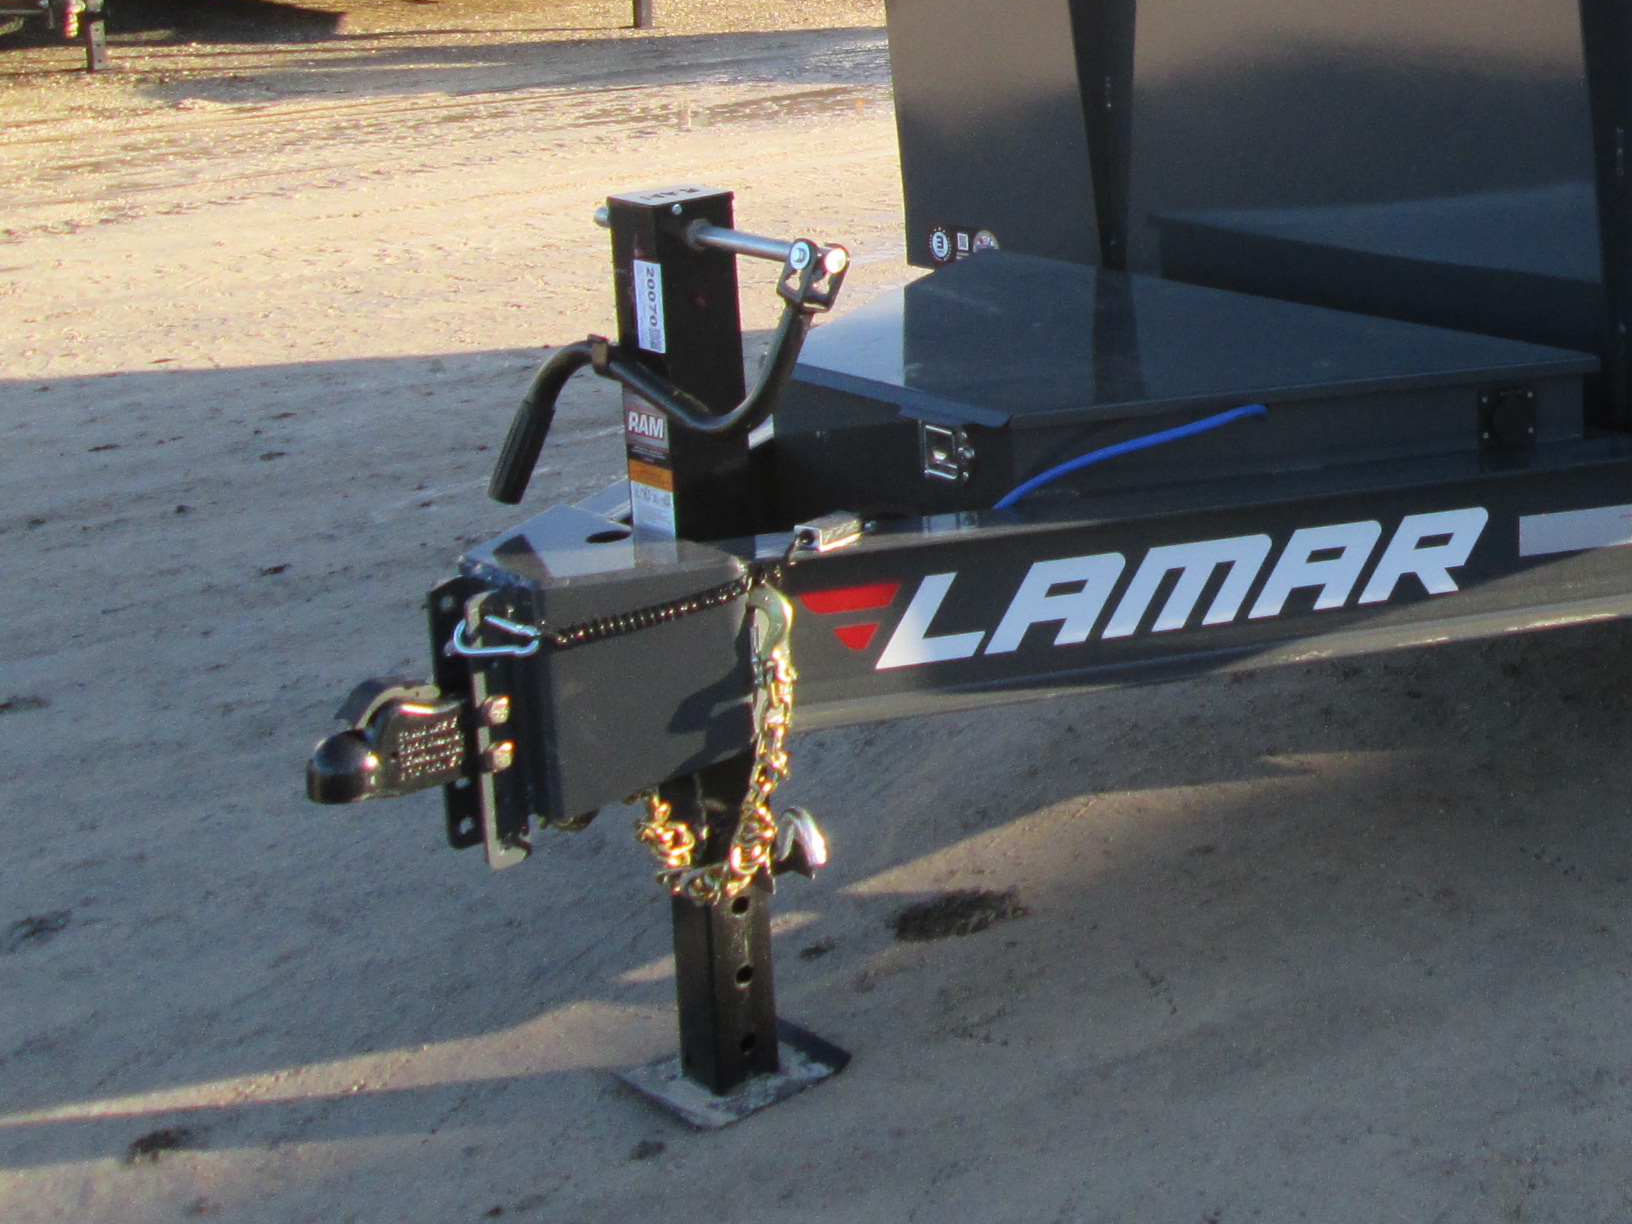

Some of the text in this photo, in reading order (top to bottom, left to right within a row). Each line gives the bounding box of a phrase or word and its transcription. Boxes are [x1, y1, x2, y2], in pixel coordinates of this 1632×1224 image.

[645, 267, 659, 327] 20070
[628, 411, 664, 439] RAM
[875, 506, 1489, 671] LAMAR
